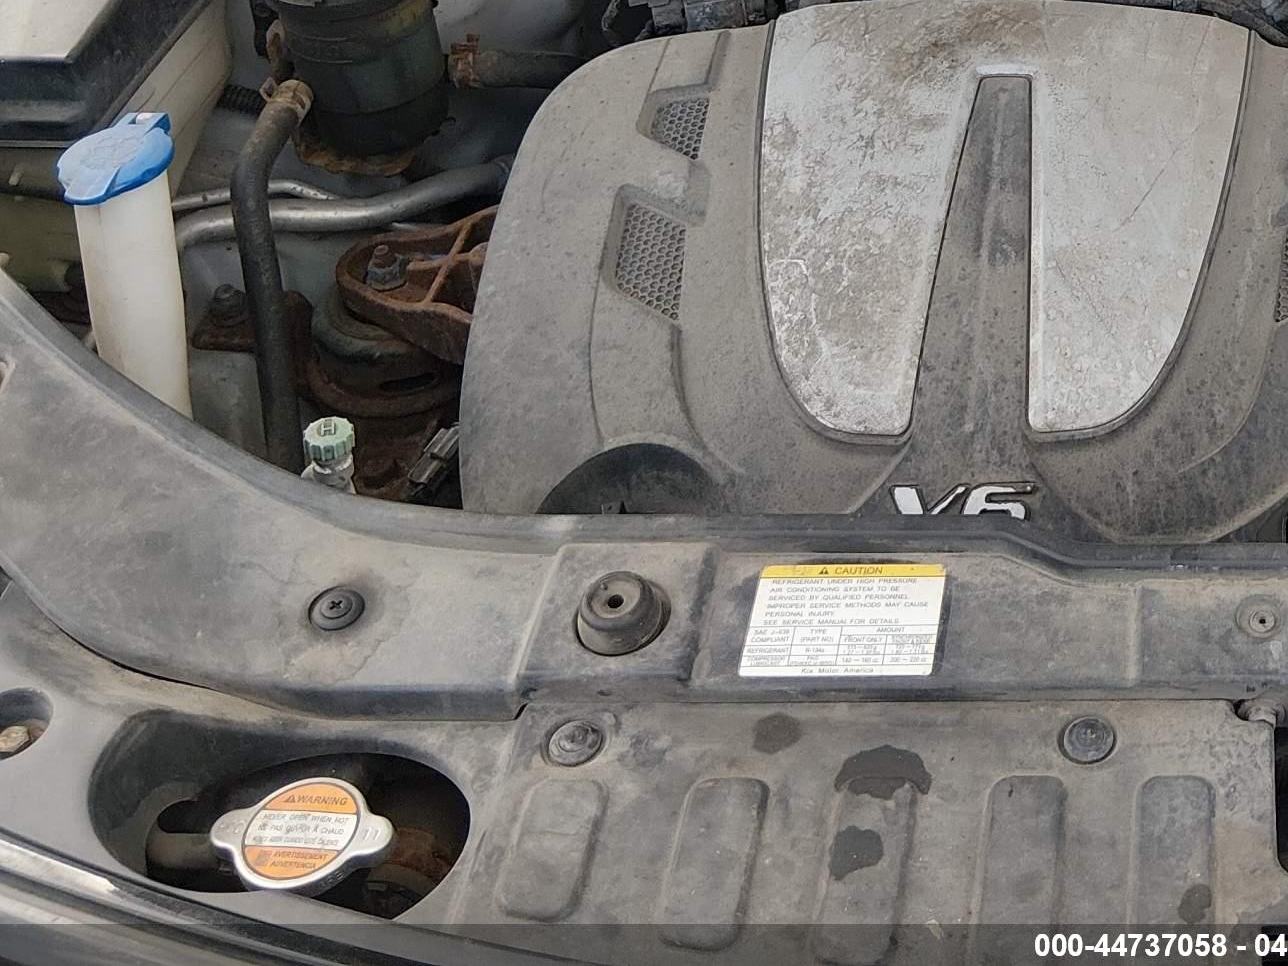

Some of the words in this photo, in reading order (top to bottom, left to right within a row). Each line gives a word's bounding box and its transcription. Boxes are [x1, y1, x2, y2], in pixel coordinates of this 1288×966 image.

[891, 482, 1034, 521] V6
[834, 566, 884, 575] CAUTION
[764, 610, 804, 618] PERSONAL
[296, 794, 349, 805] WARNING
